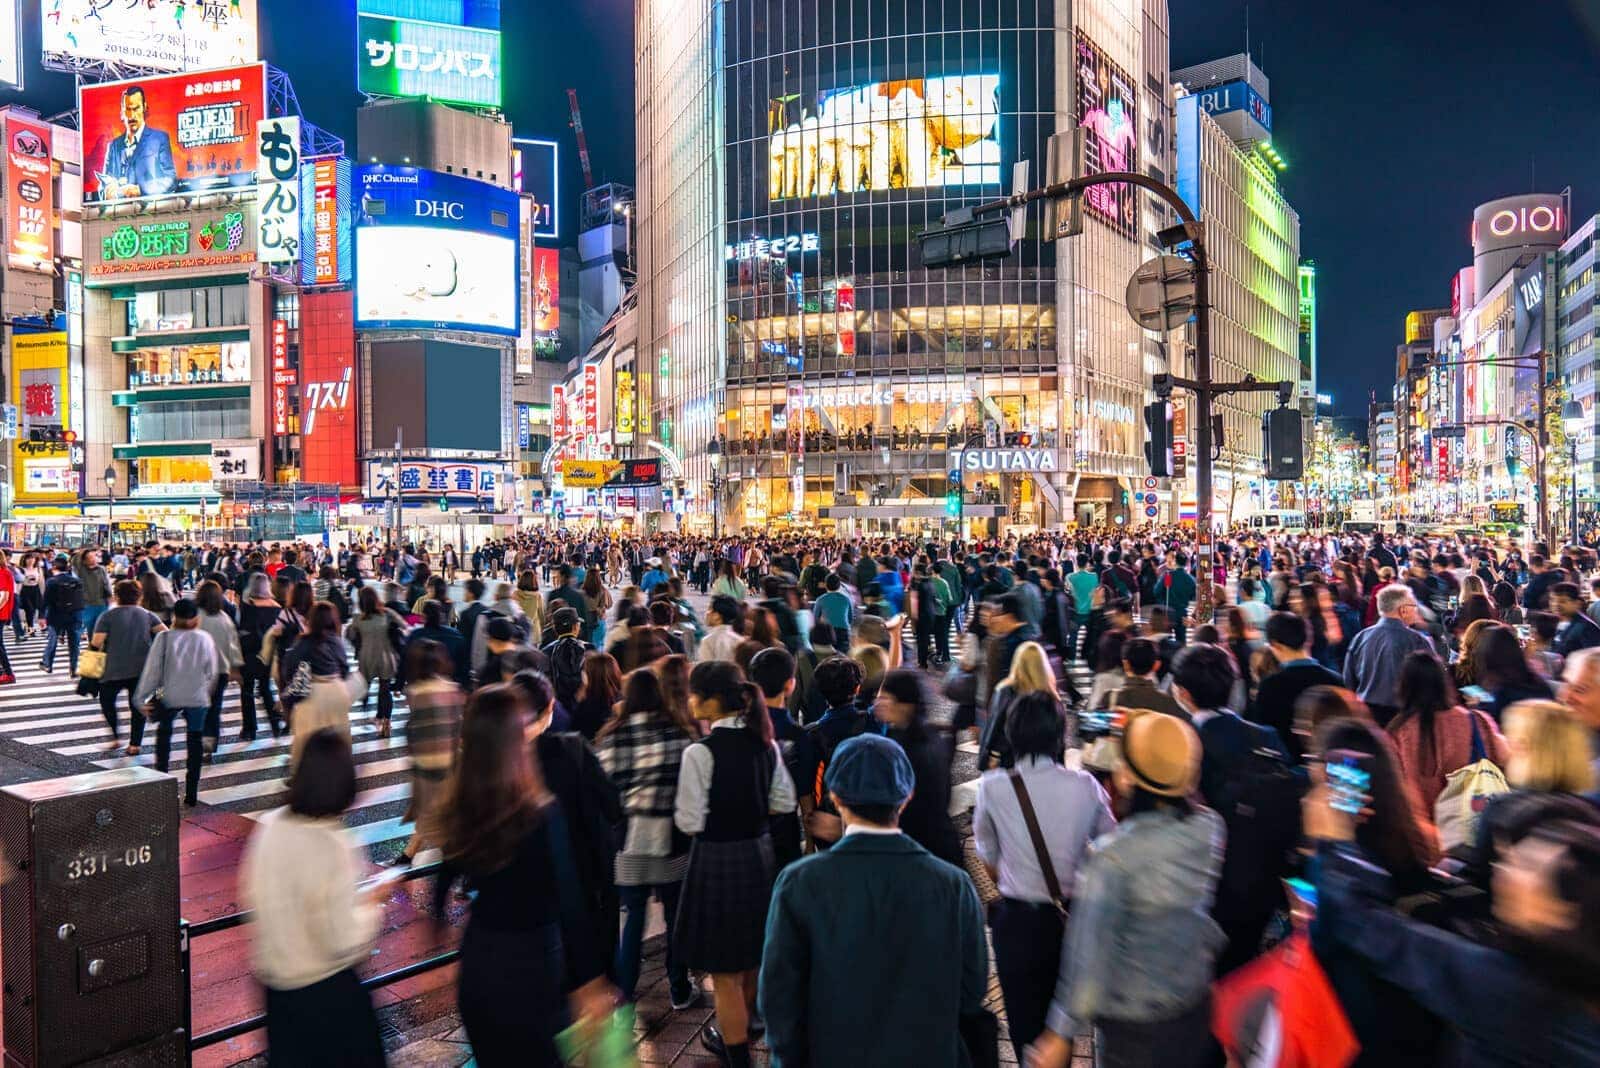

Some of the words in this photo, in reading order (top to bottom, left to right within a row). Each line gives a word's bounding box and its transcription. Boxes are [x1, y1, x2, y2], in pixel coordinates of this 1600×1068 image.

[365, 38, 495, 80] サロンパス
[260, 121, 298, 257] もんじゃ
[362, 174, 382, 184] DHC
[383, 173, 418, 184] Channel
[414, 199, 465, 220] DHC
[1520, 271, 1542, 311] ZAR
[950, 450, 1055, 470] TSUTAYA
[375, 467, 495, 492] 大盛堂書店
[68, 845, 152, 880] 331-06
